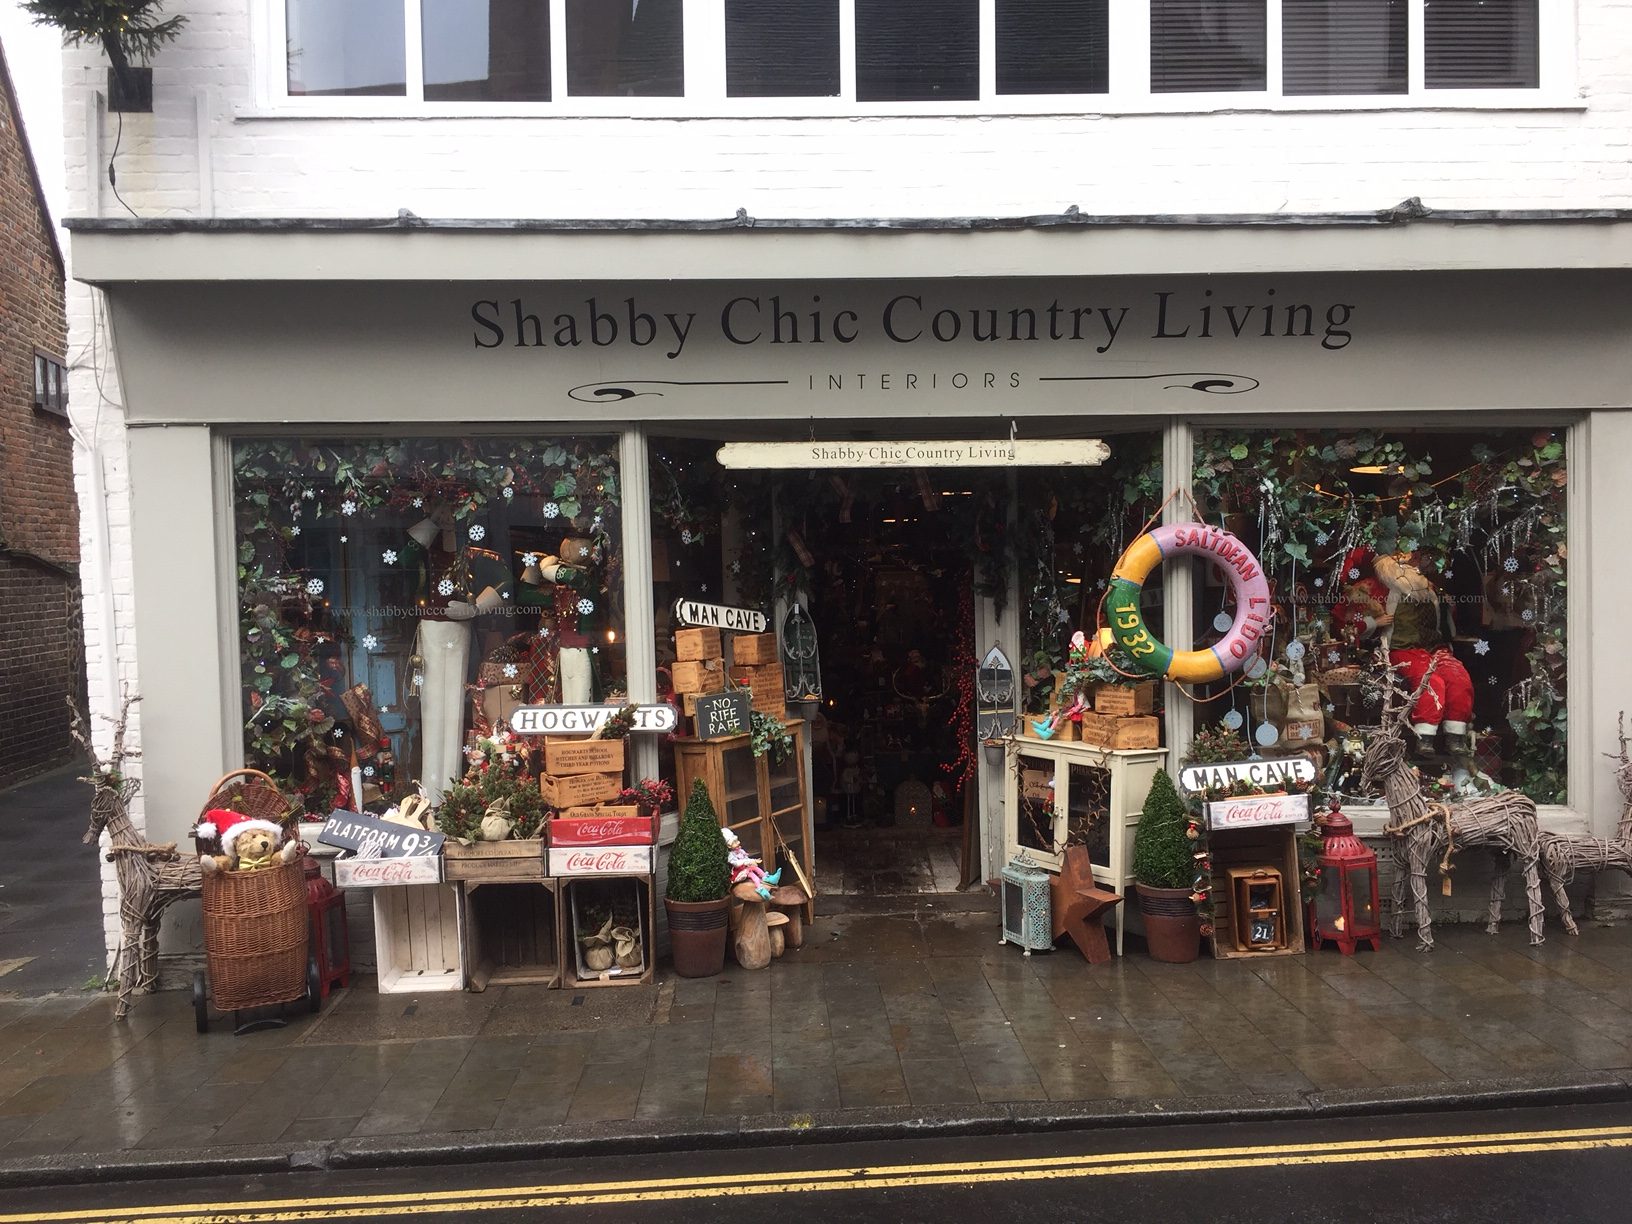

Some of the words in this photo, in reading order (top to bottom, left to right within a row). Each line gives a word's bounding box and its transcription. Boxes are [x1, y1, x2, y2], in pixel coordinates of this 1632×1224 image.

[471, 296, 697, 360] Shabby
[720, 294, 860, 345] Chic
[882, 293, 1130, 354] Country
[1151, 288, 1356, 350] Living
[808, 372, 1022, 391] INTERIORS
[812, 446, 864, 463] Shabby
[868, 446, 903, 460] Chic
[905, 445, 964, 461] Country
[967, 445, 1016, 461] Living
[1174, 528, 1260, 582] SALTDEAN
[1229, 596, 1267, 660] LIDO
[688, 603, 720, 626] MAN
[725, 608, 761, 631] CAVE
[1115, 602, 1156, 659] 1932
[709, 707, 738, 722] RIFF
[711, 697, 732, 711] NO
[520, 709, 667, 730] HOGWTS
[708, 718, 741, 735] RAFF
[1192, 766, 1239, 790] MAN
[1249, 761, 1304, 784] CAVE
[323, 818, 402, 851] PLATFORM
